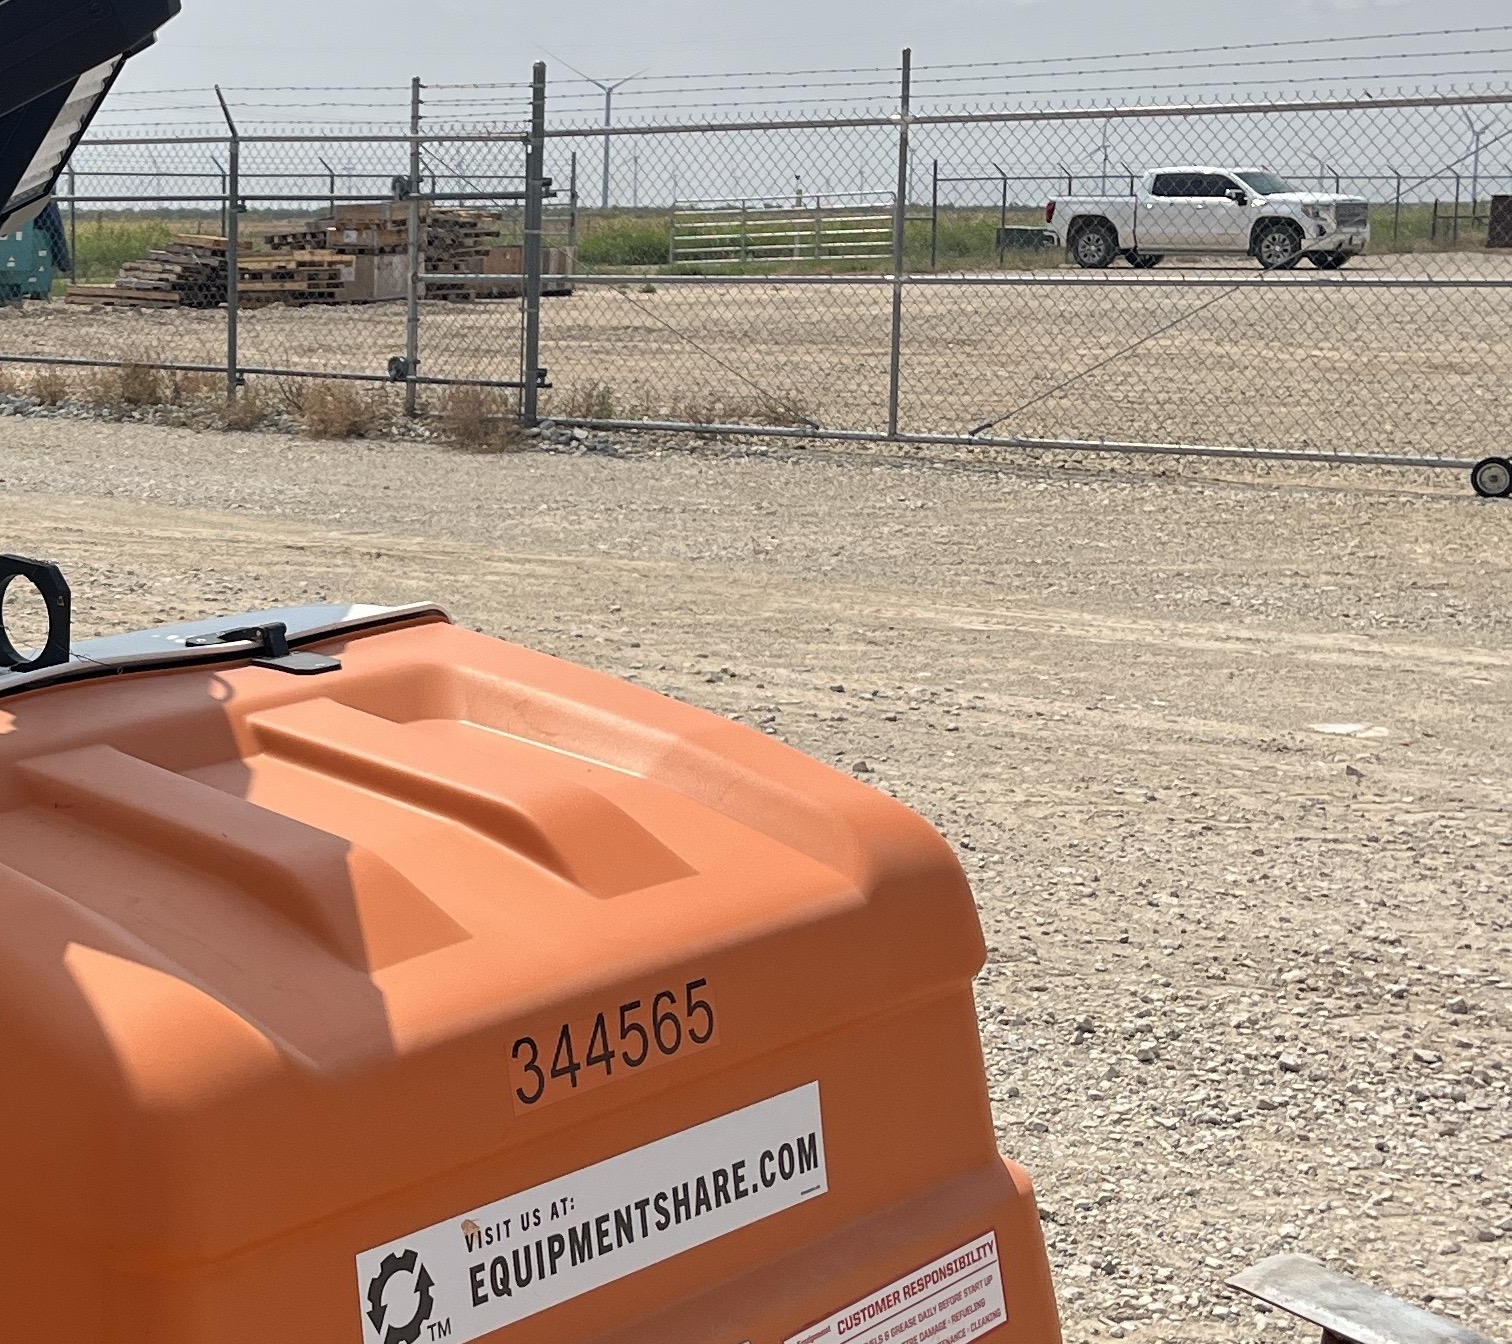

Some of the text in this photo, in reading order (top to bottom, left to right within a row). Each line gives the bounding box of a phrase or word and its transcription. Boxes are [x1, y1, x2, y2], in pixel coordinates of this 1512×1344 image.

[511, 977, 714, 1105] 344565
[464, 1196, 576, 1253] VISIT US AT:
[469, 1131, 819, 1308] EQUIPMENTSHARE.COM
[837, 1239, 994, 1336] CUSTOMER RESPONSIBILITY
[890, 1316, 917, 1338] GREASE
[918, 1304, 938, 1324] DAILY
[938, 1291, 963, 1312] BEFORE
[963, 1279, 984, 1299] START
[983, 1274, 994, 1288] UP
[426, 1317, 453, 1342] TM
[919, 1319, 947, 1343] DAMAGE
[950, 1298, 986, 1324] REFUELING
[970, 1307, 1002, 1333] CLEANING
